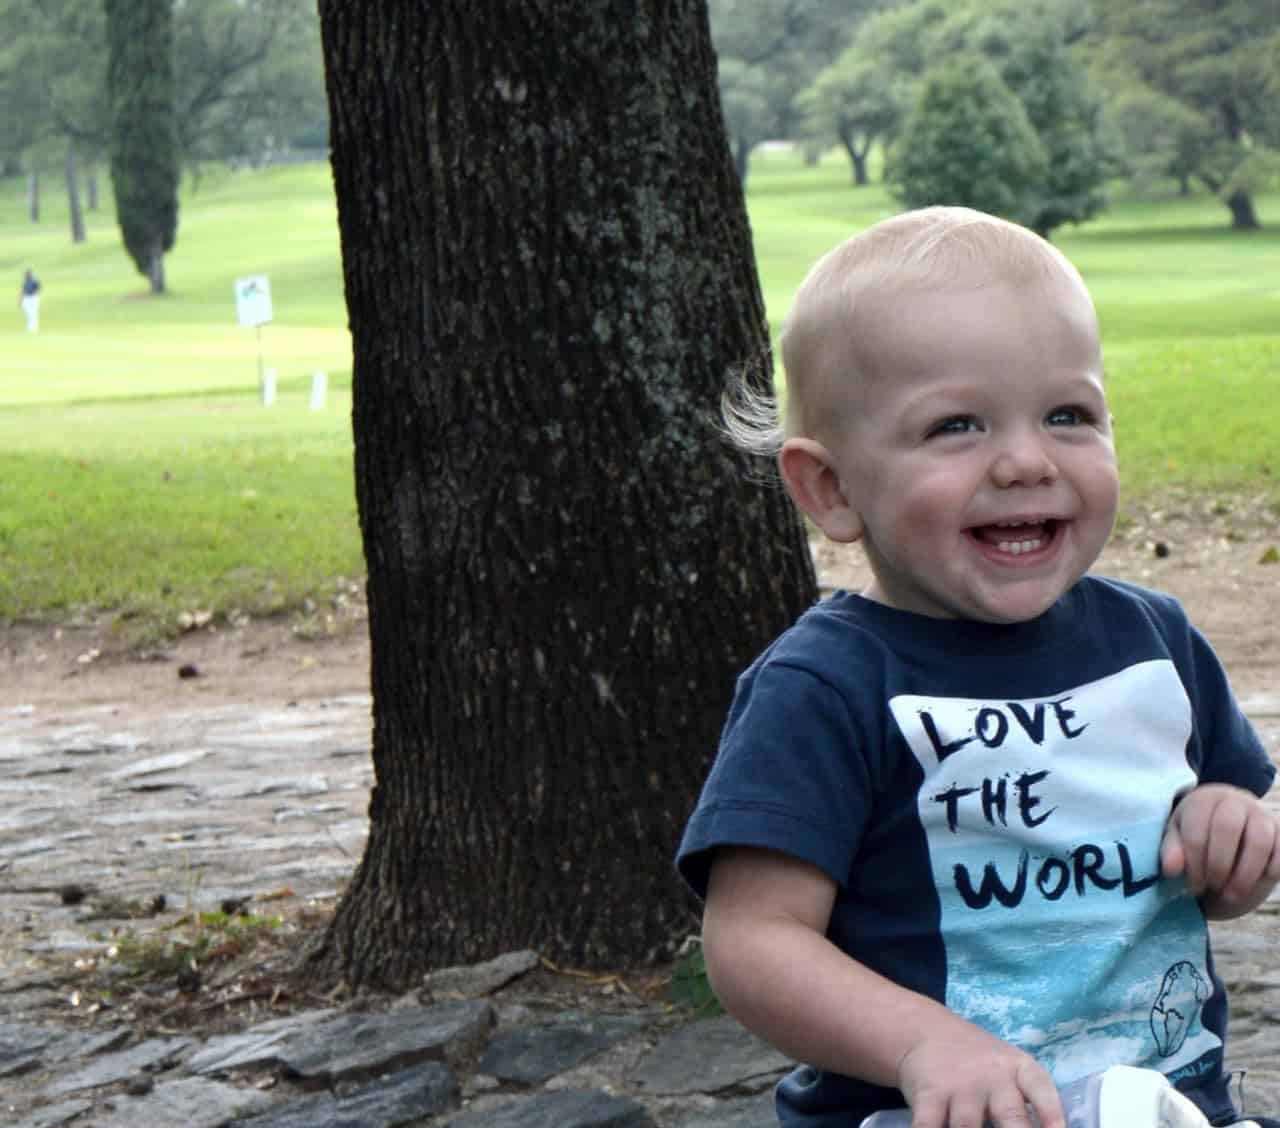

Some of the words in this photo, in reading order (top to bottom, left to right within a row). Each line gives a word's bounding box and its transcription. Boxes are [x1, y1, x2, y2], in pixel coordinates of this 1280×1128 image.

[918, 696, 1089, 763] LOVE
[929, 769, 1058, 834] THE
[954, 843, 1161, 909] WORL
